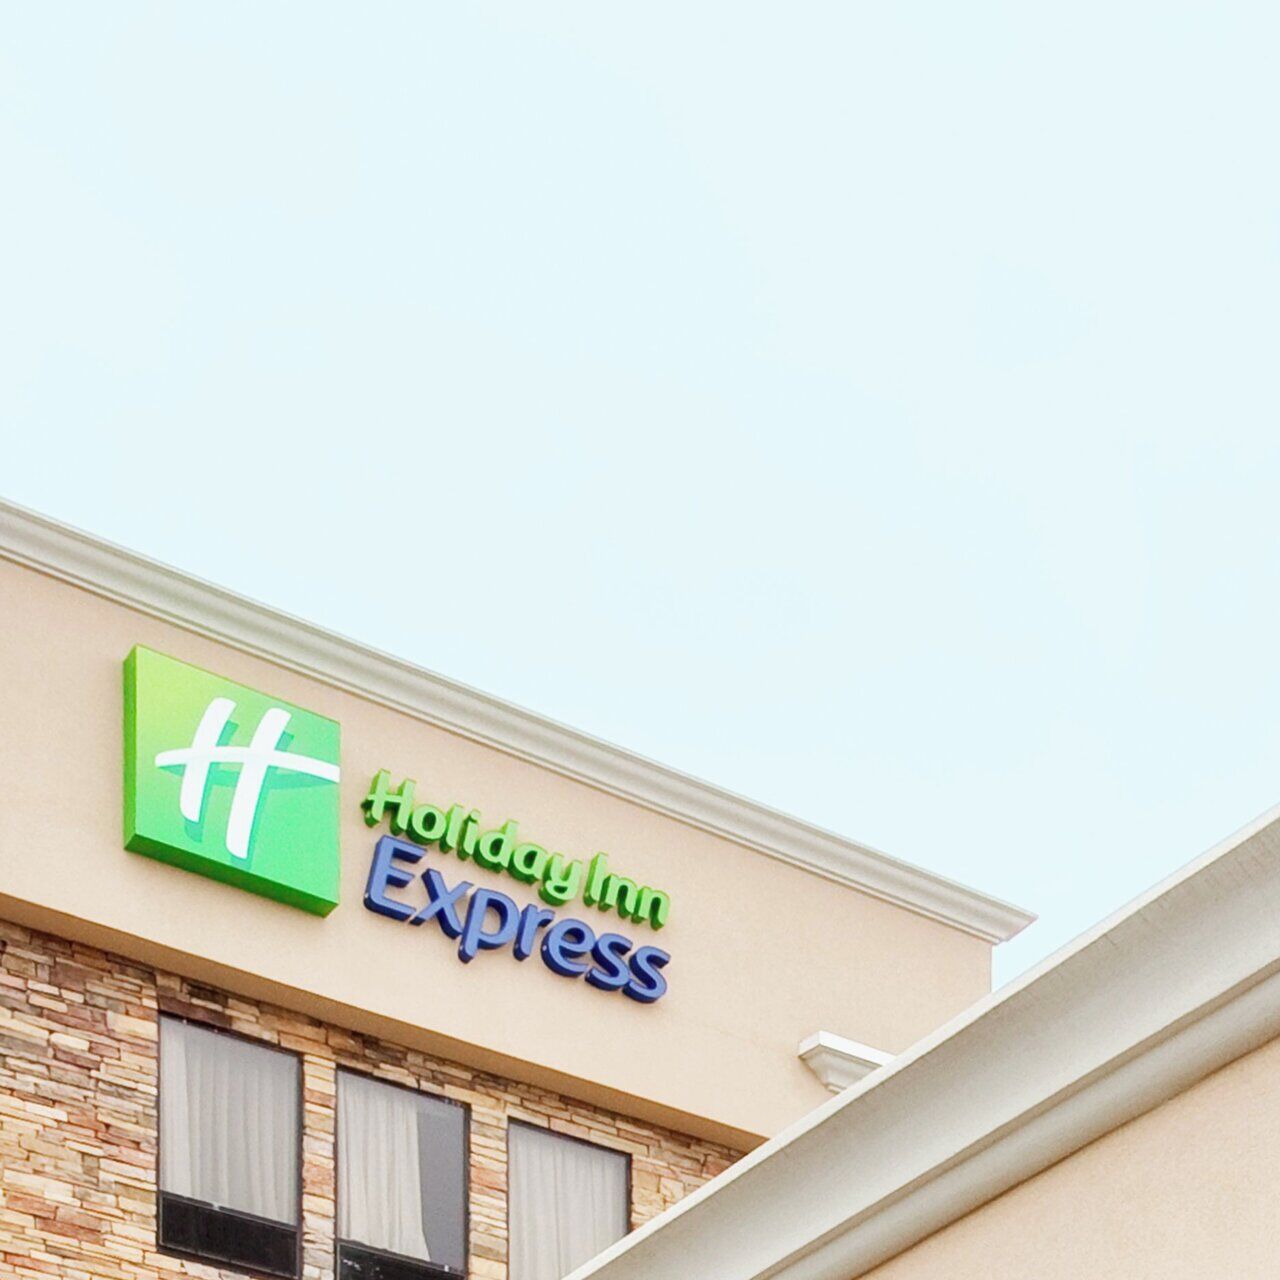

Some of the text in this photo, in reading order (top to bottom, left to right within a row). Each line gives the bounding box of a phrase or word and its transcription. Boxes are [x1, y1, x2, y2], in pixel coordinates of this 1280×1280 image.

[361, 768, 670, 931] Holiday Inn
[363, 834, 671, 1004] Express
